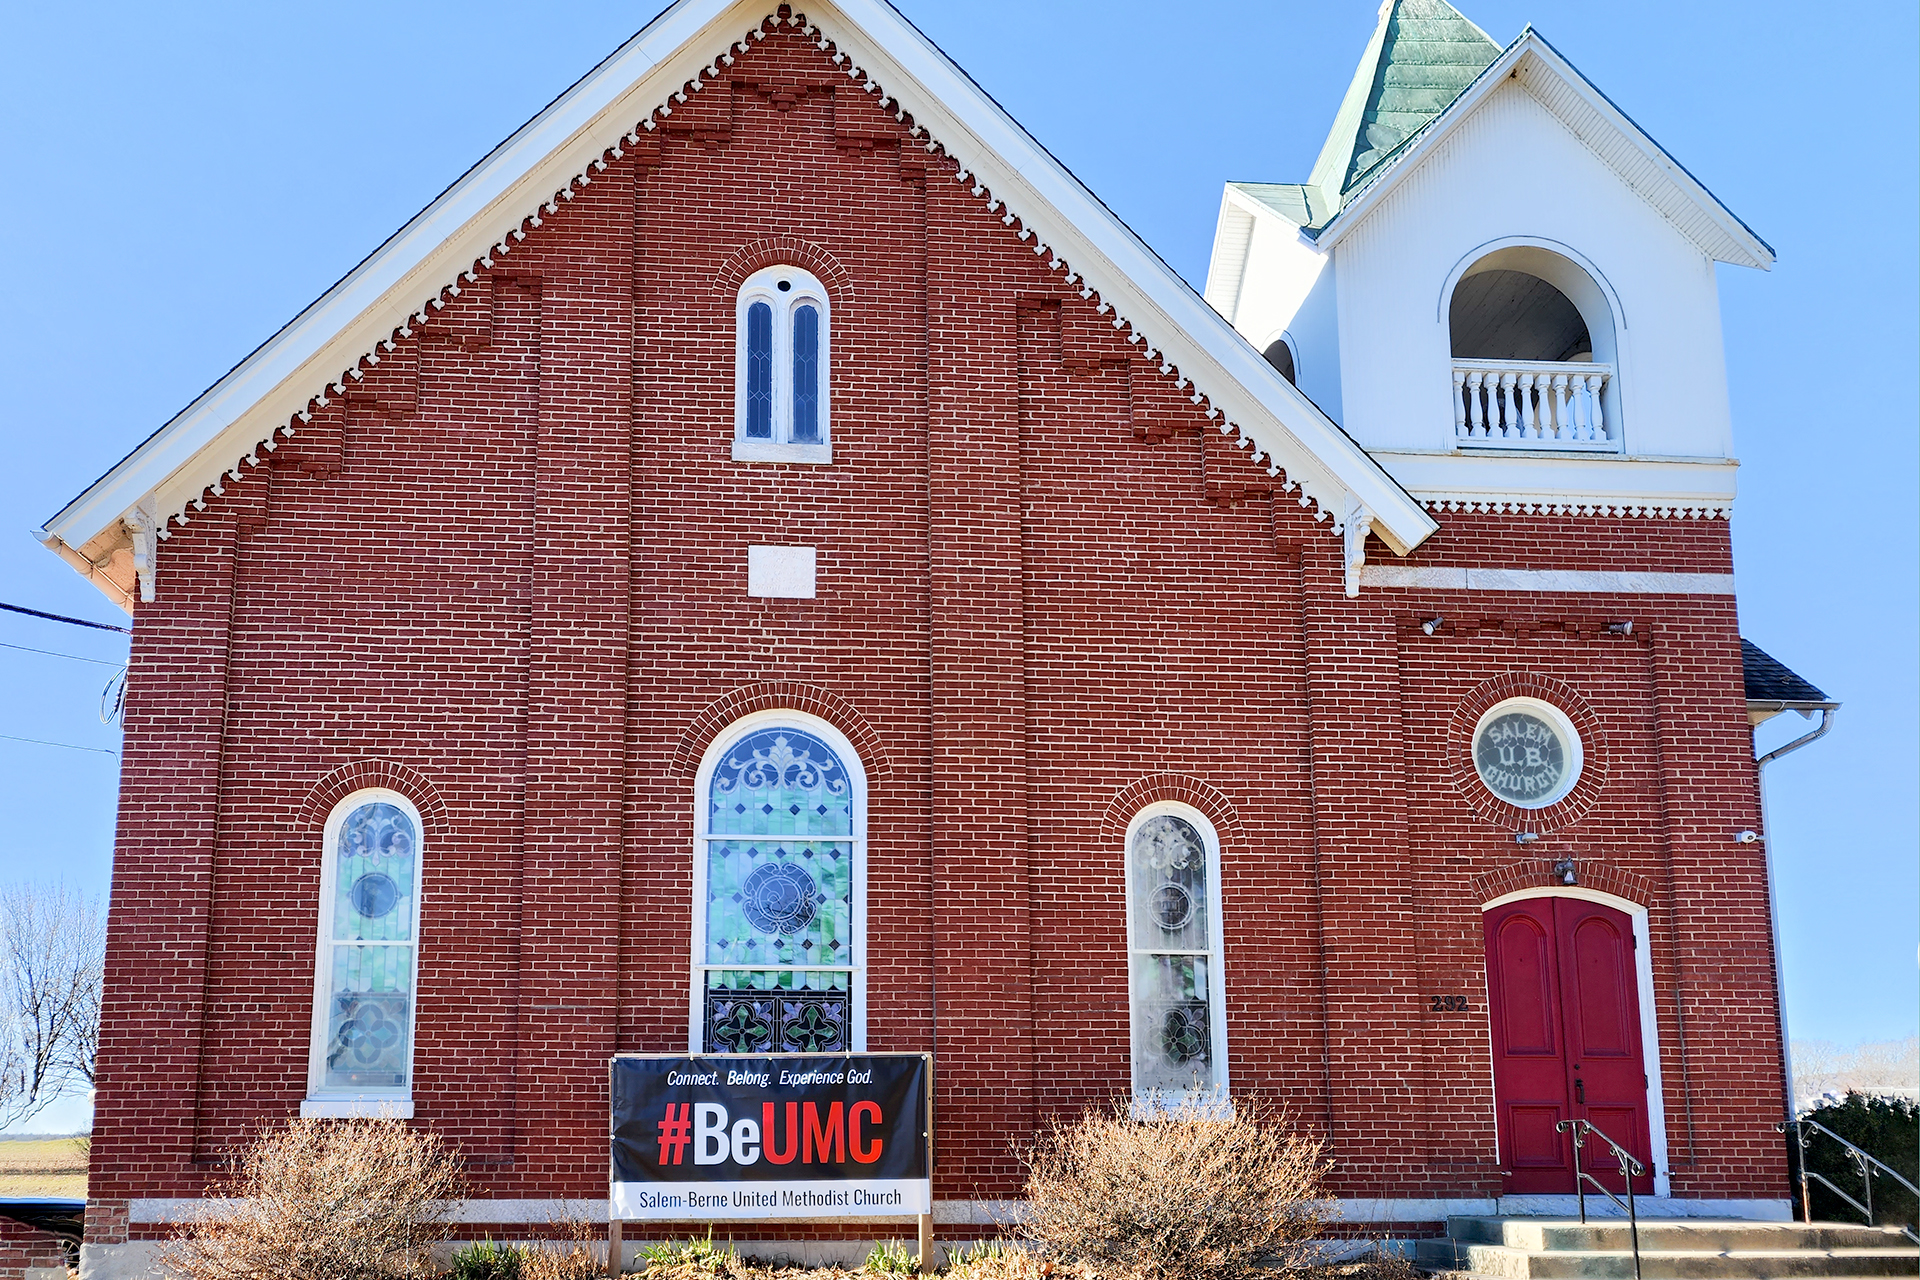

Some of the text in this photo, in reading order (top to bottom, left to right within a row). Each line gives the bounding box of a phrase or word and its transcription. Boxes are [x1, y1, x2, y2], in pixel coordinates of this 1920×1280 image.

[1488, 722, 1553, 744] SALEM
[1483, 764, 1560, 791] CHURCH
[1431, 995, 1469, 1012] 292
[667, 1068, 874, 1088] Connect. Belong. Experience God.
[657, 1100, 883, 1166] #BeUMC
[639, 1188, 902, 1208] Salem-Berne United Methodist Church
